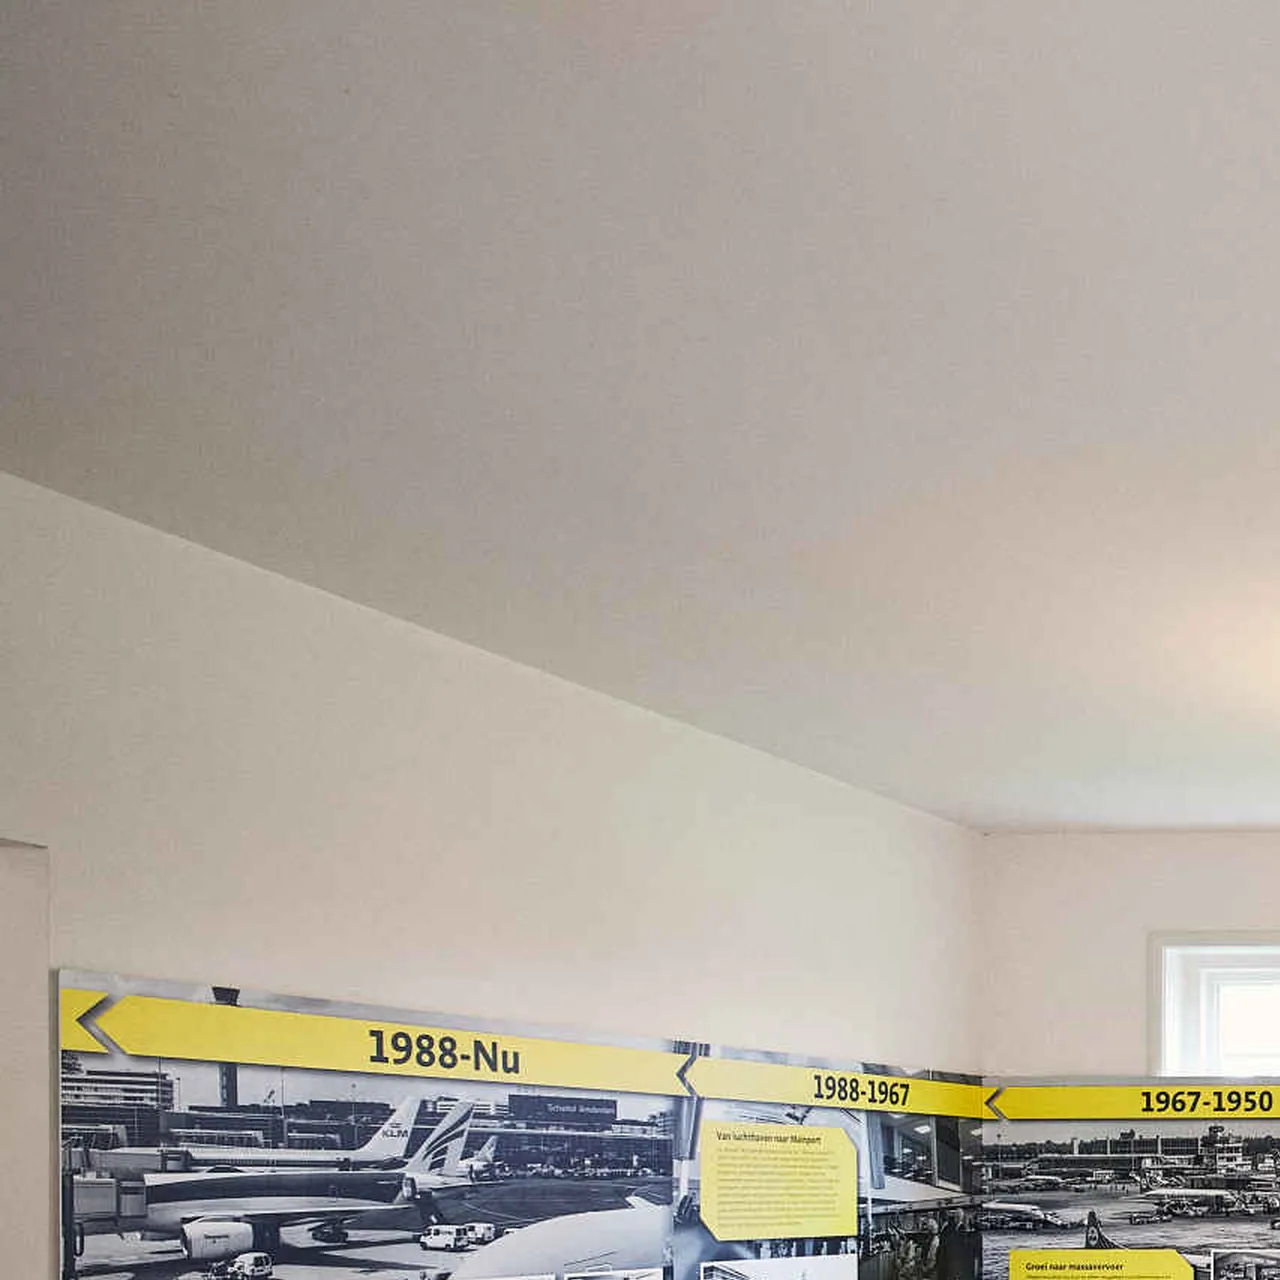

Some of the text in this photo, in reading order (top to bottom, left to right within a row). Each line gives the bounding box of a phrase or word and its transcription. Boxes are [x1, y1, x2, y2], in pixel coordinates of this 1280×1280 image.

[368, 1029, 520, 1074] 1988-Nu
[813, 1073, 910, 1106] 1988-1967
[1140, 1091, 1274, 1113] 1967-1950
[382, 1129, 409, 1139] KLM
